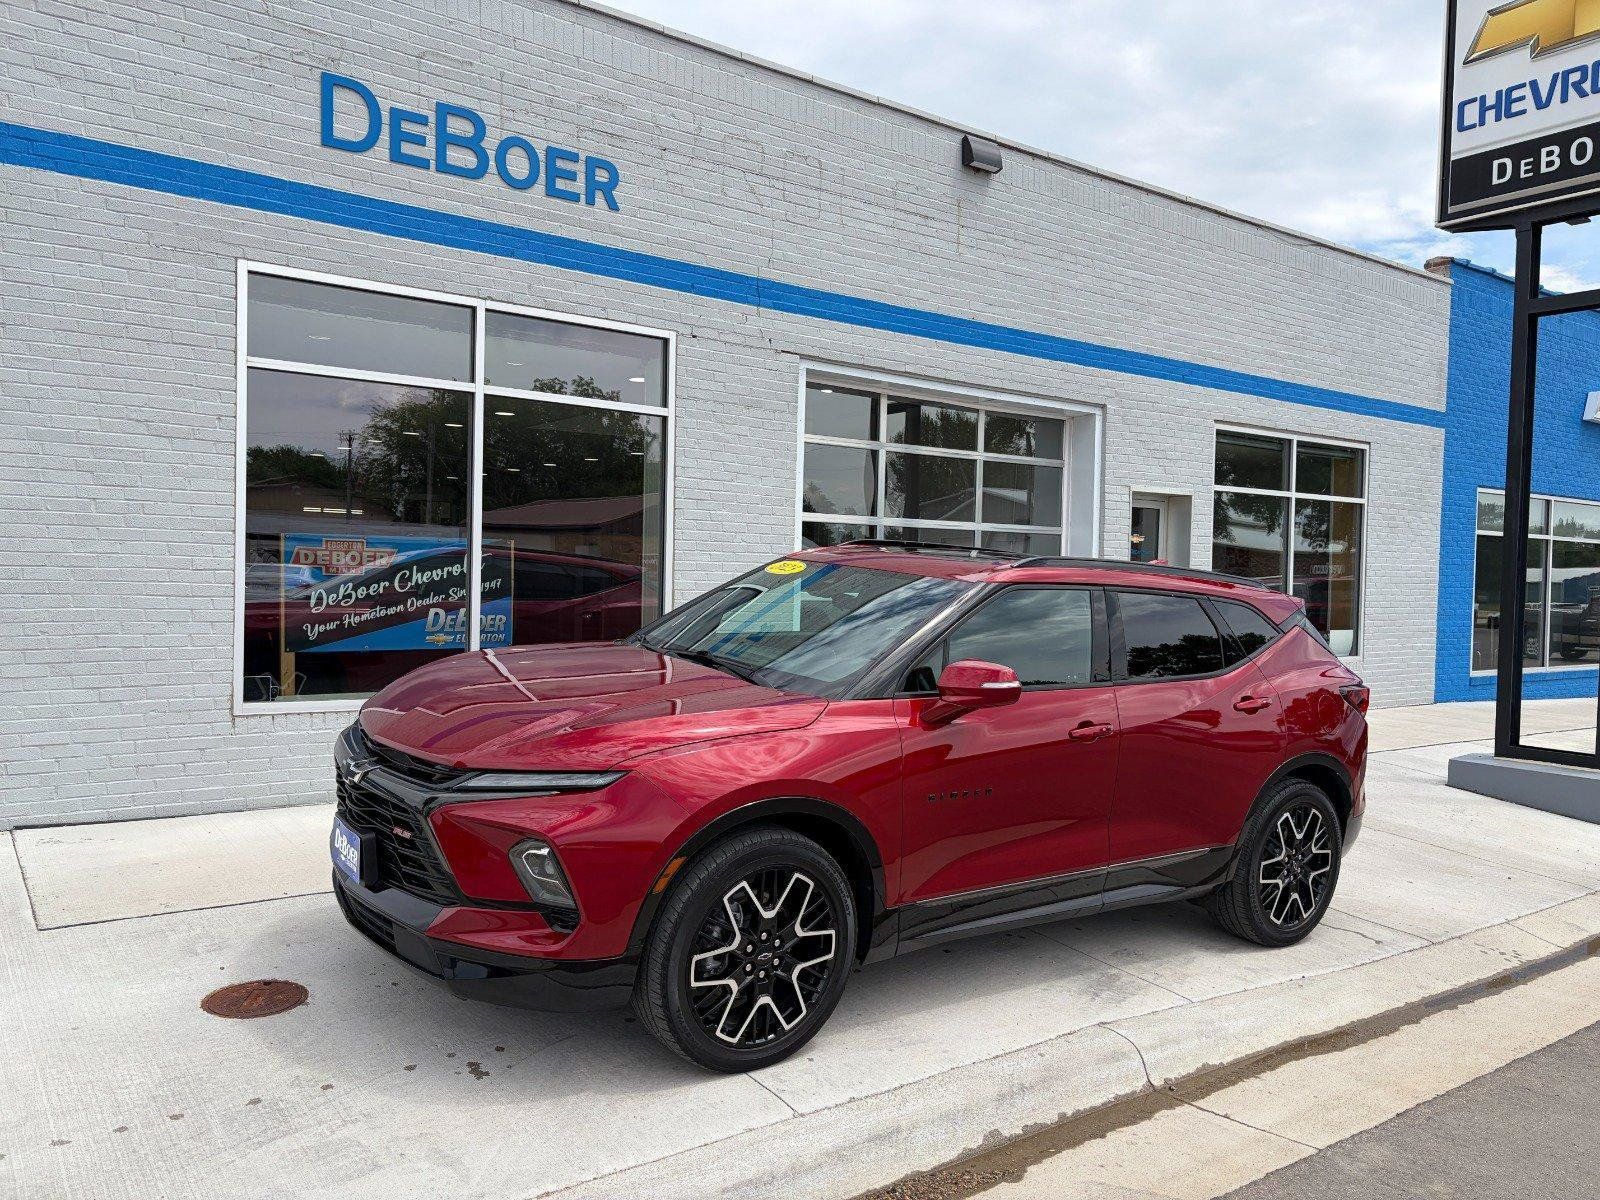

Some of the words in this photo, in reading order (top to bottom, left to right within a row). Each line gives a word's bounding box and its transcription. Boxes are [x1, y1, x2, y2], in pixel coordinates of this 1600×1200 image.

[321, 71, 620, 211] DEBOER
[299, 549, 389, 566] DEBOER
[309, 580, 389, 613] DeBoer
[394, 553, 493, 592] Chevrol
[302, 620, 340, 641] Your
[343, 604, 405, 628] Hometown
[407, 591, 446, 612] Dealer
[448, 587, 467, 601] Sin
[455, 633, 506, 643] EDRTON
